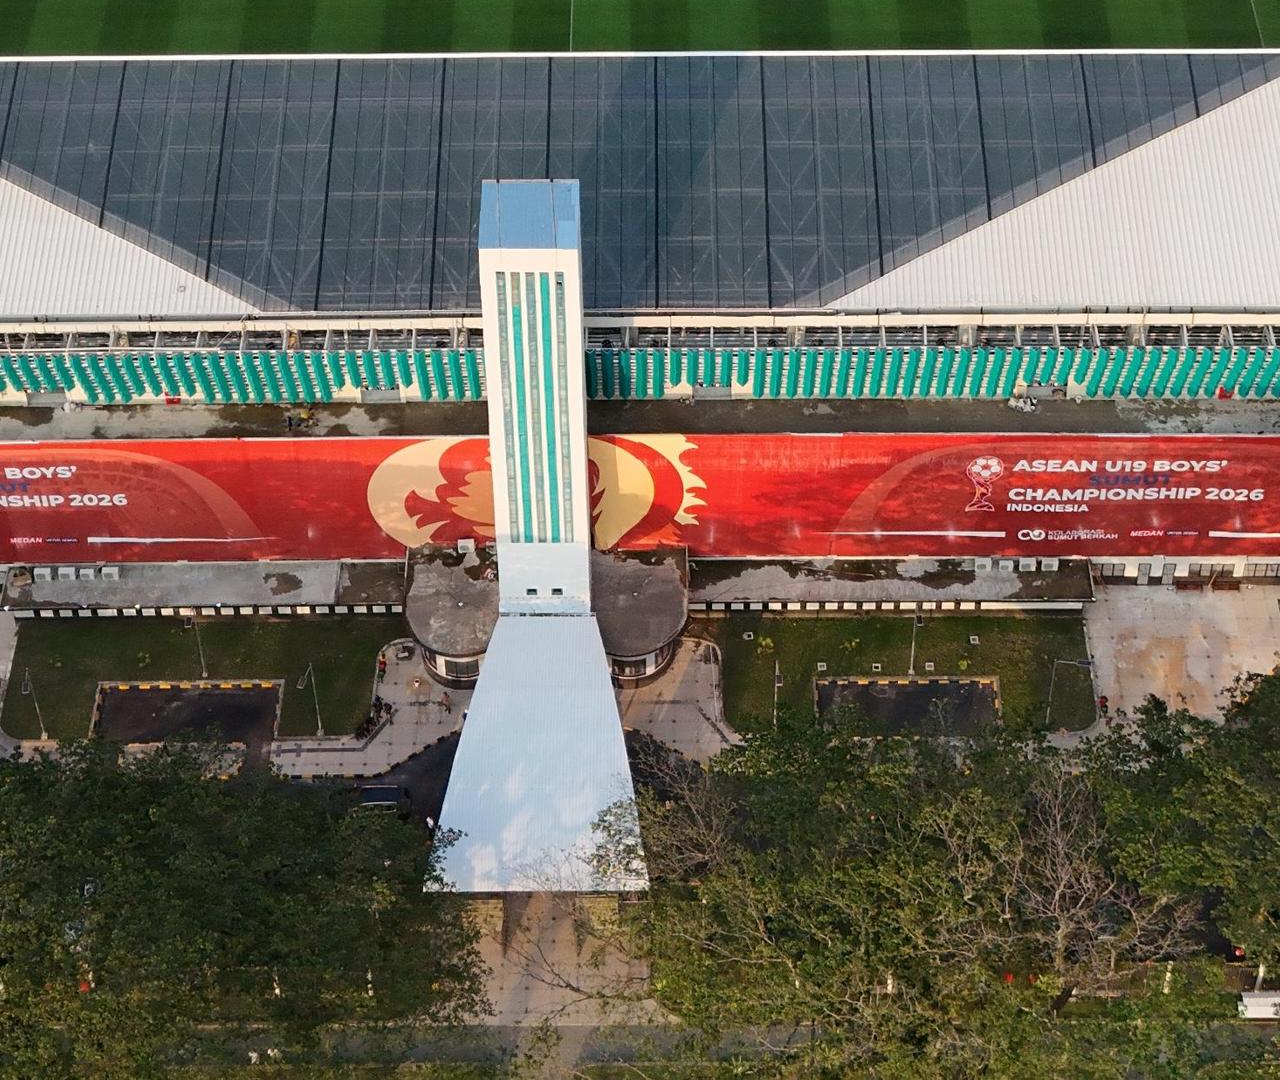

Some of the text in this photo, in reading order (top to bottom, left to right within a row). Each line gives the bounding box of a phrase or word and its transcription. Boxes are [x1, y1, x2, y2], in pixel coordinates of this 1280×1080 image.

[5, 465, 76, 479] BOYS'
[1012, 459, 1228, 473] ASEAN U19 BOYS'
[1088, 473, 1173, 487] SUMUT
[68, 493, 128, 507] 2026
[1008, 487, 1265, 502] CHAMPIONSHIP 2026
[1006, 503, 1090, 513] INDONESIA
